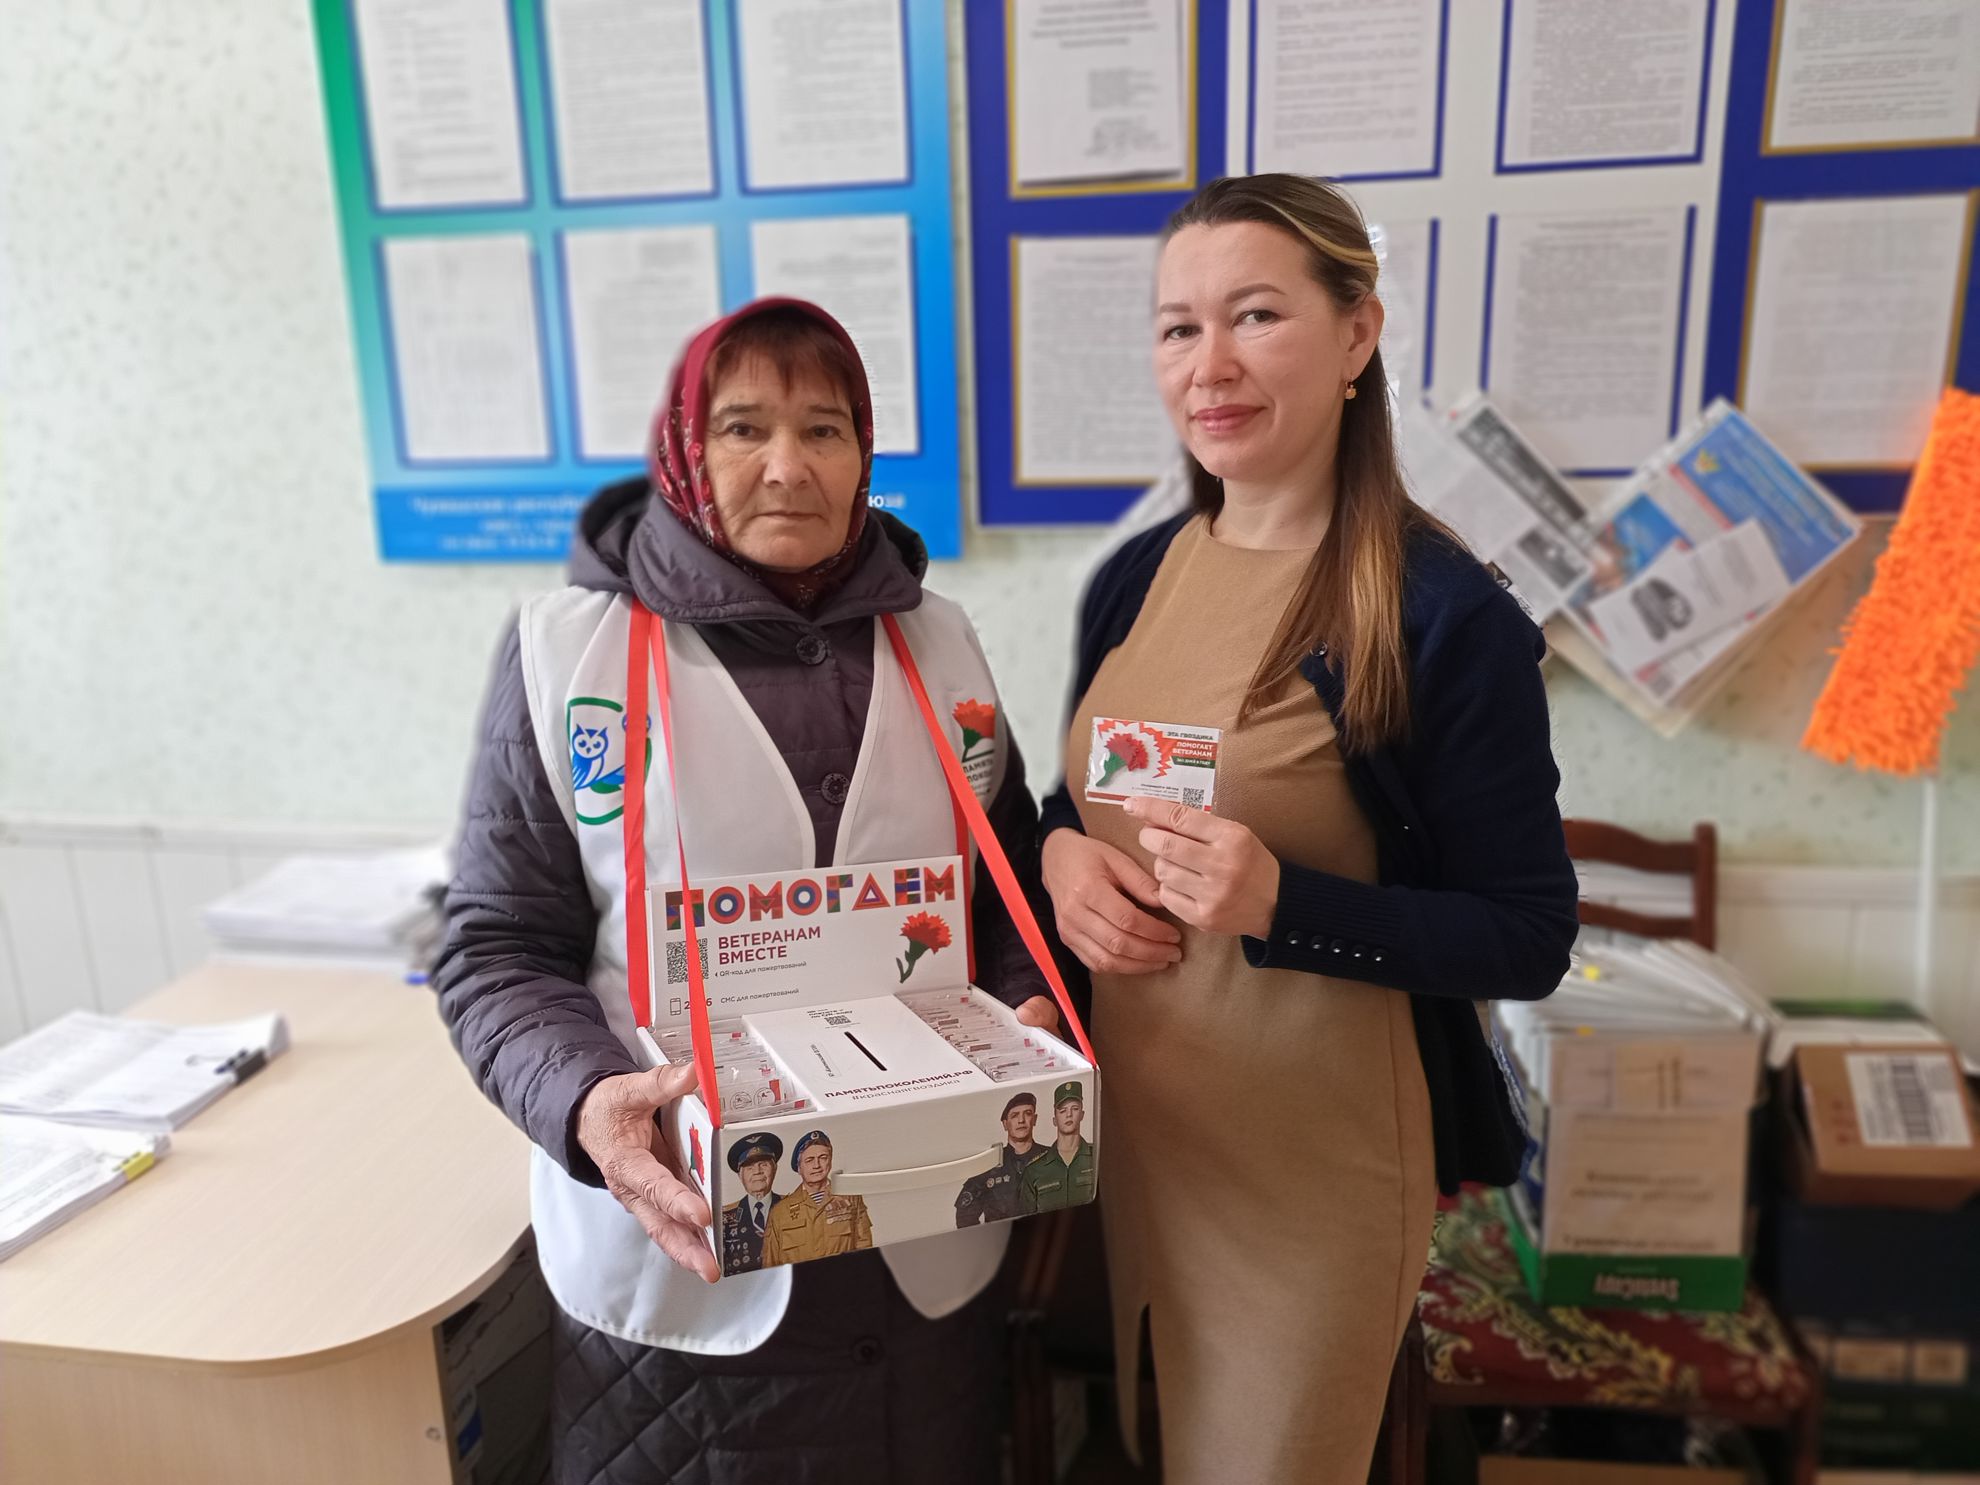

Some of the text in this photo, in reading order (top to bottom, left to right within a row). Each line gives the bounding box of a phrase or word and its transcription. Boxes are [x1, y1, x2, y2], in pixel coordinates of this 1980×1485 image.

[1172, 747, 1213, 757] ВЕТЕРАНАМ
[1176, 741, 1213, 750] ПОМОГАЕТ
[665, 864, 956, 931] ПОМОГАЕМ
[718, 926, 821, 949] ВЕТЕРАНАМ
[719, 945, 787, 965] ВМЕСТЕ
[757, 961, 807, 972] пожертвований
[750, 988, 799, 1000] пожертвований
[684, 997, 713, 1010] 26
[824, 1069, 974, 1098] ПАМЯТЬПОКОЛЕНИЙ.РФ
